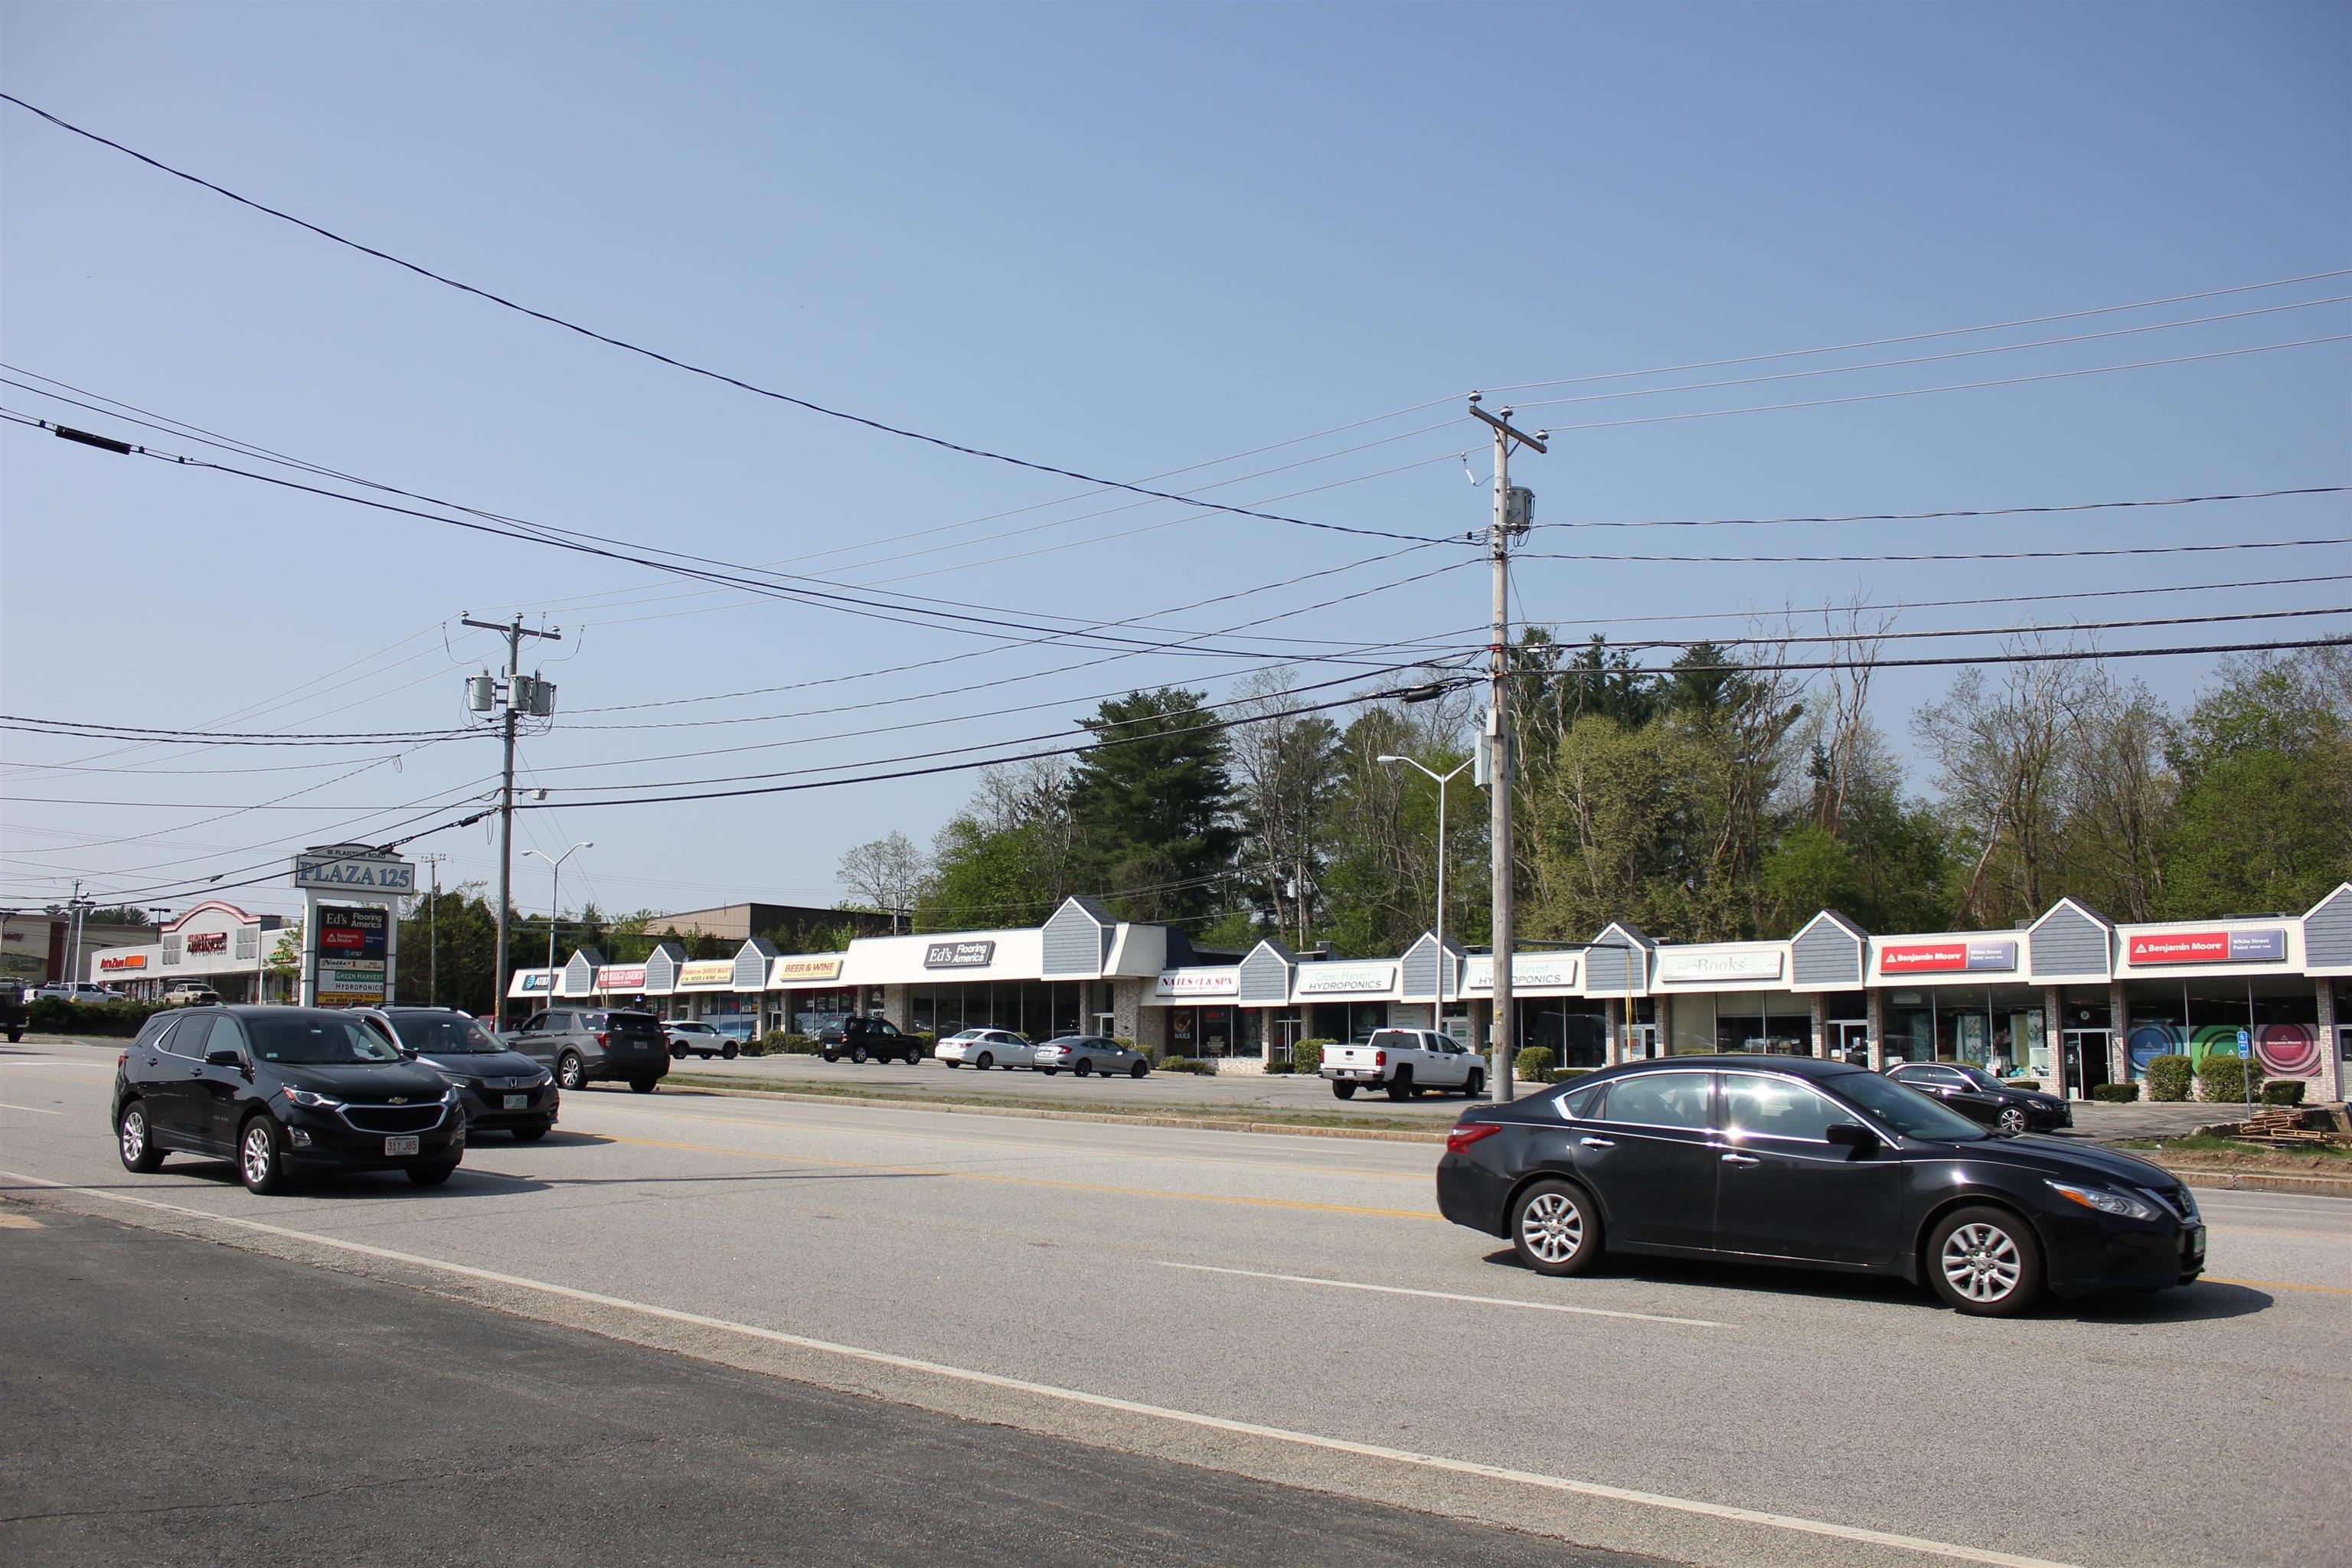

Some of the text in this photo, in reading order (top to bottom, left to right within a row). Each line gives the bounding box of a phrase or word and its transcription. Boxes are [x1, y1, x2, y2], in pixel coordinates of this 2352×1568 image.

[299, 861, 410, 887] PLAZA 125
[326, 913, 382, 925] Ed's Flooring
[351, 920, 382, 929] America
[928, 943, 988, 962] Ed's Flooring
[2148, 943, 2190, 954] Benjamin
[2191, 942, 2222, 951] Moore
[952, 953, 985, 963] America
[1897, 952, 1933, 962] Benjamin
[785, 962, 835, 972] BEER & WINE
[1697, 957, 1745, 972] Books
[1316, 971, 1371, 981] Green Harvest
[1479, 975, 1561, 985] HYOPONICS
[1161, 977, 1193, 986] NAILS
[1214, 977, 1232, 985] SPA
[1309, 981, 1382, 990] HYDROPONICS
